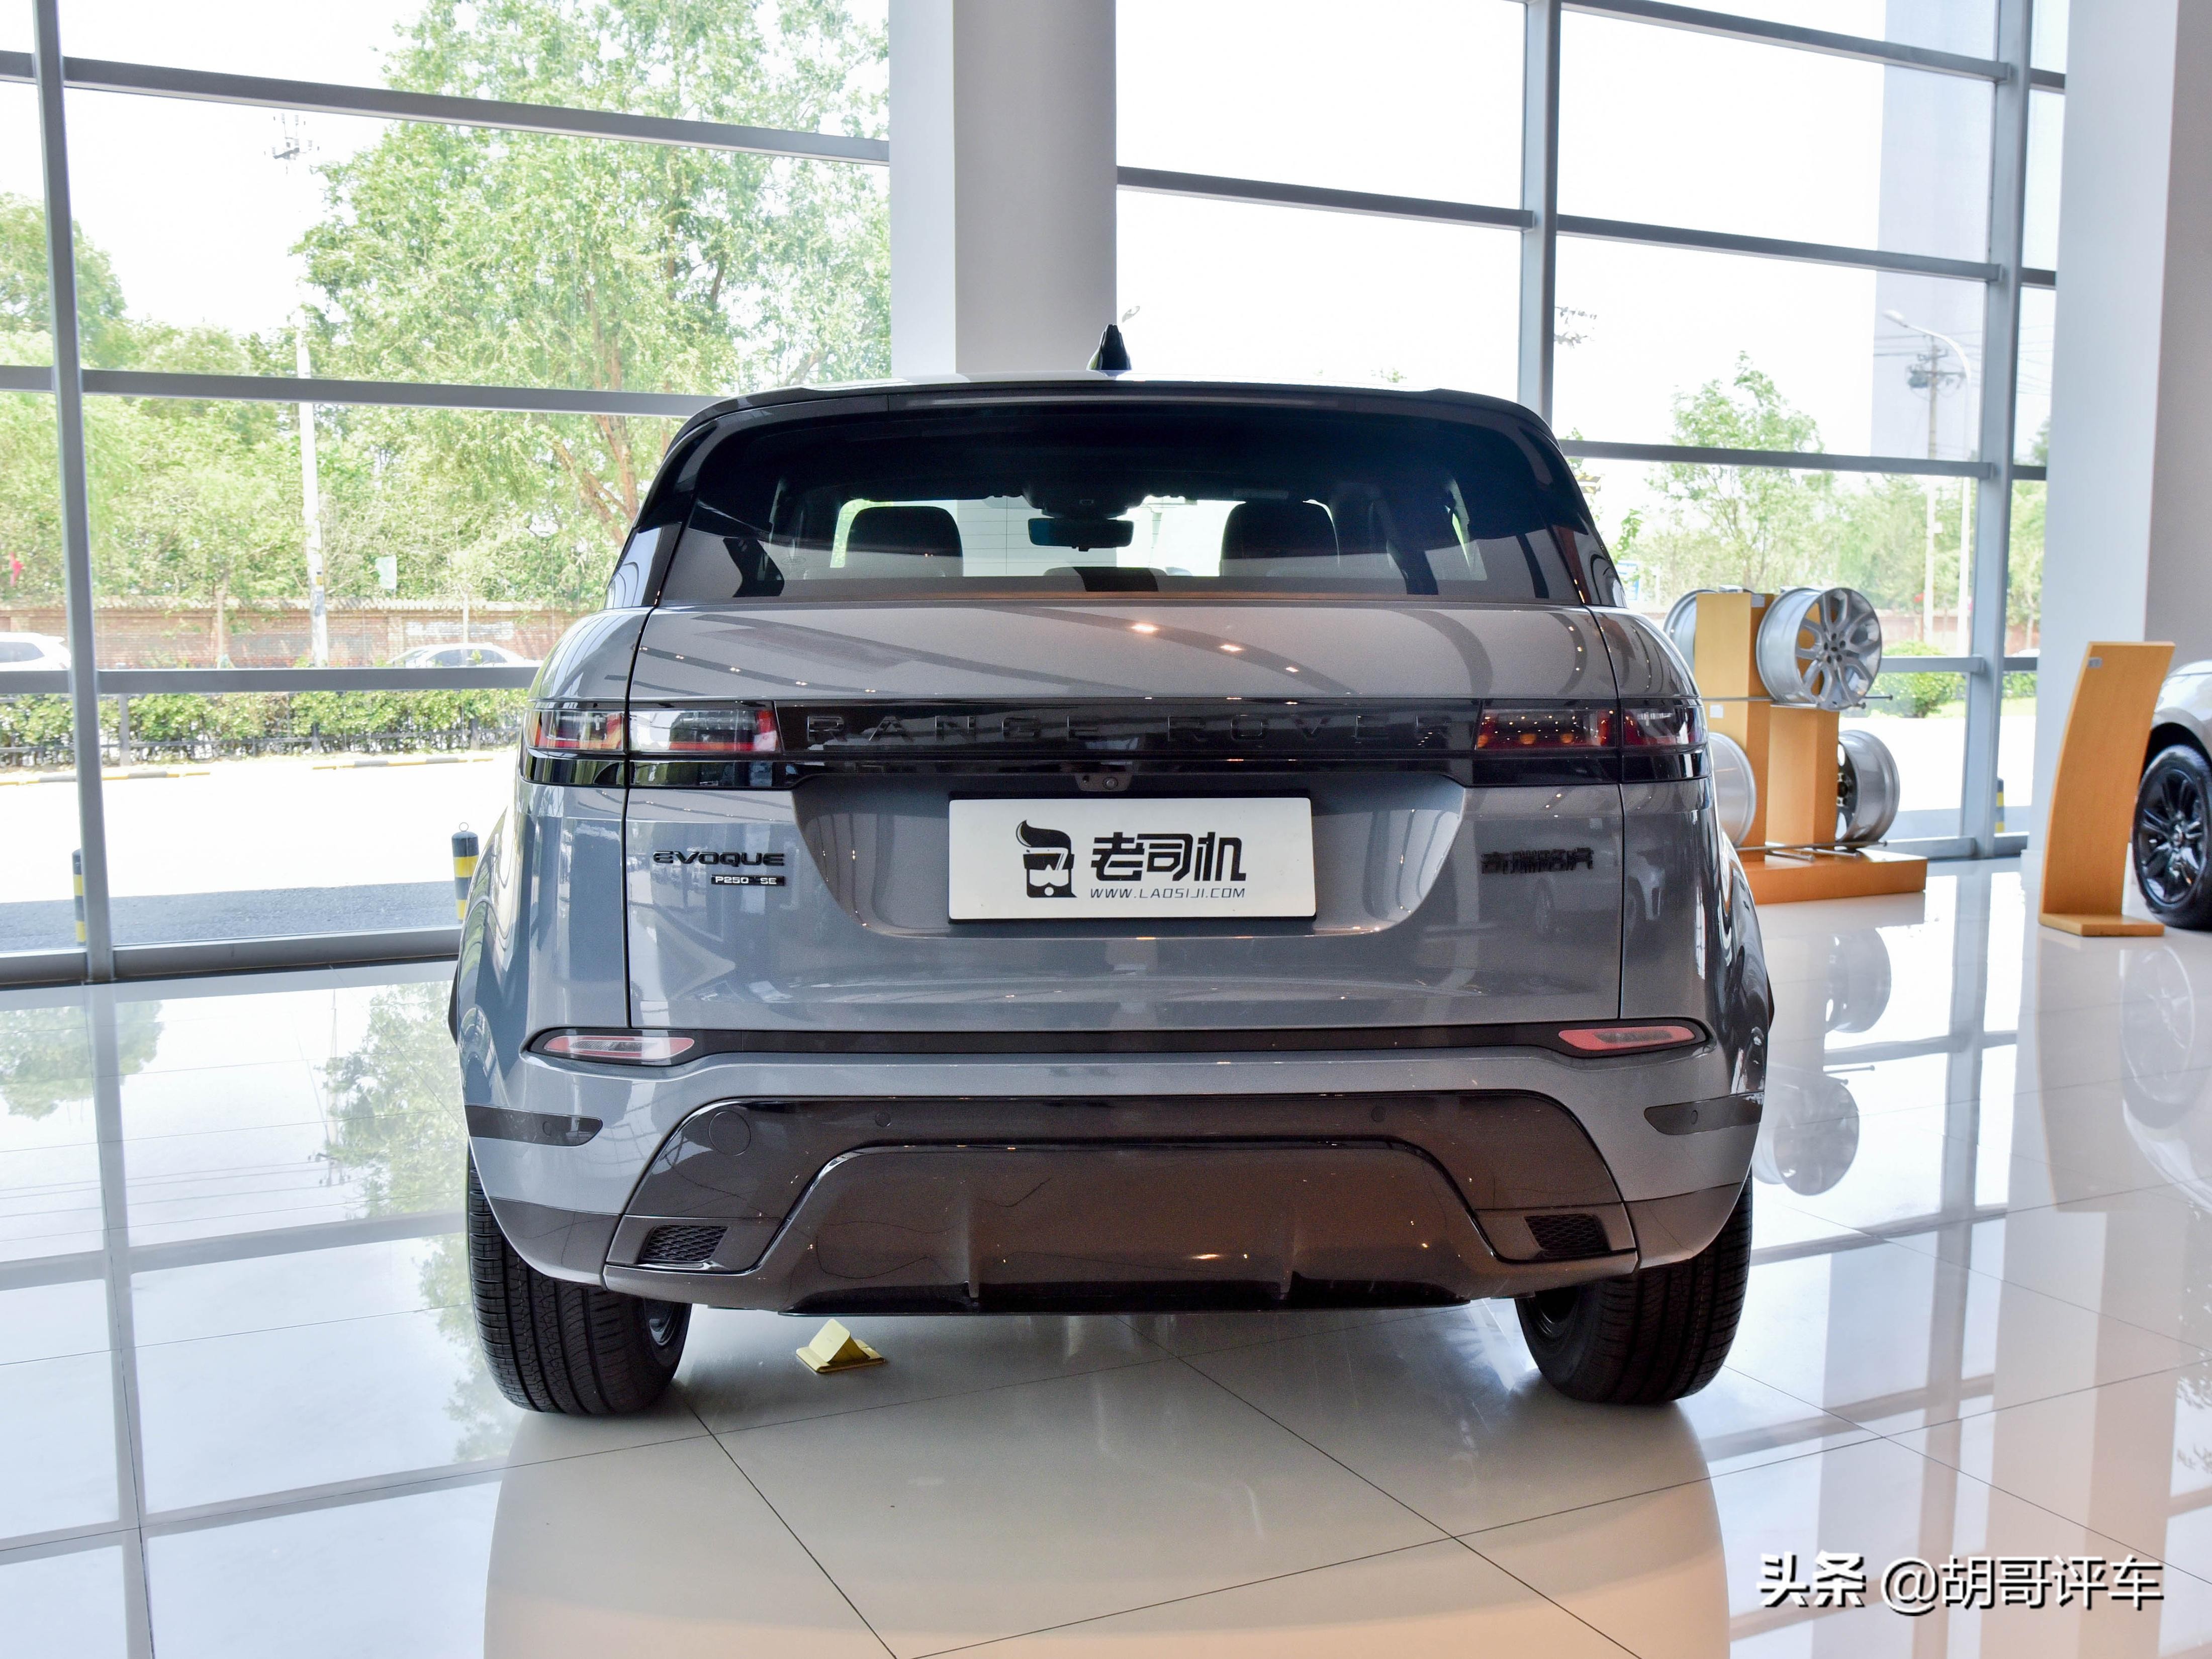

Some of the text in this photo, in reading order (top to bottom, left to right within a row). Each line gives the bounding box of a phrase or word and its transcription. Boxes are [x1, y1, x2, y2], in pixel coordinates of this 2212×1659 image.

[806, 714, 1102, 743] RANGE
[653, 850, 785, 867] EVOQUE
[1090, 831, 1247, 881] 老司机
[1090, 887, 1246, 898] WWW.LAOSIJI.COM
